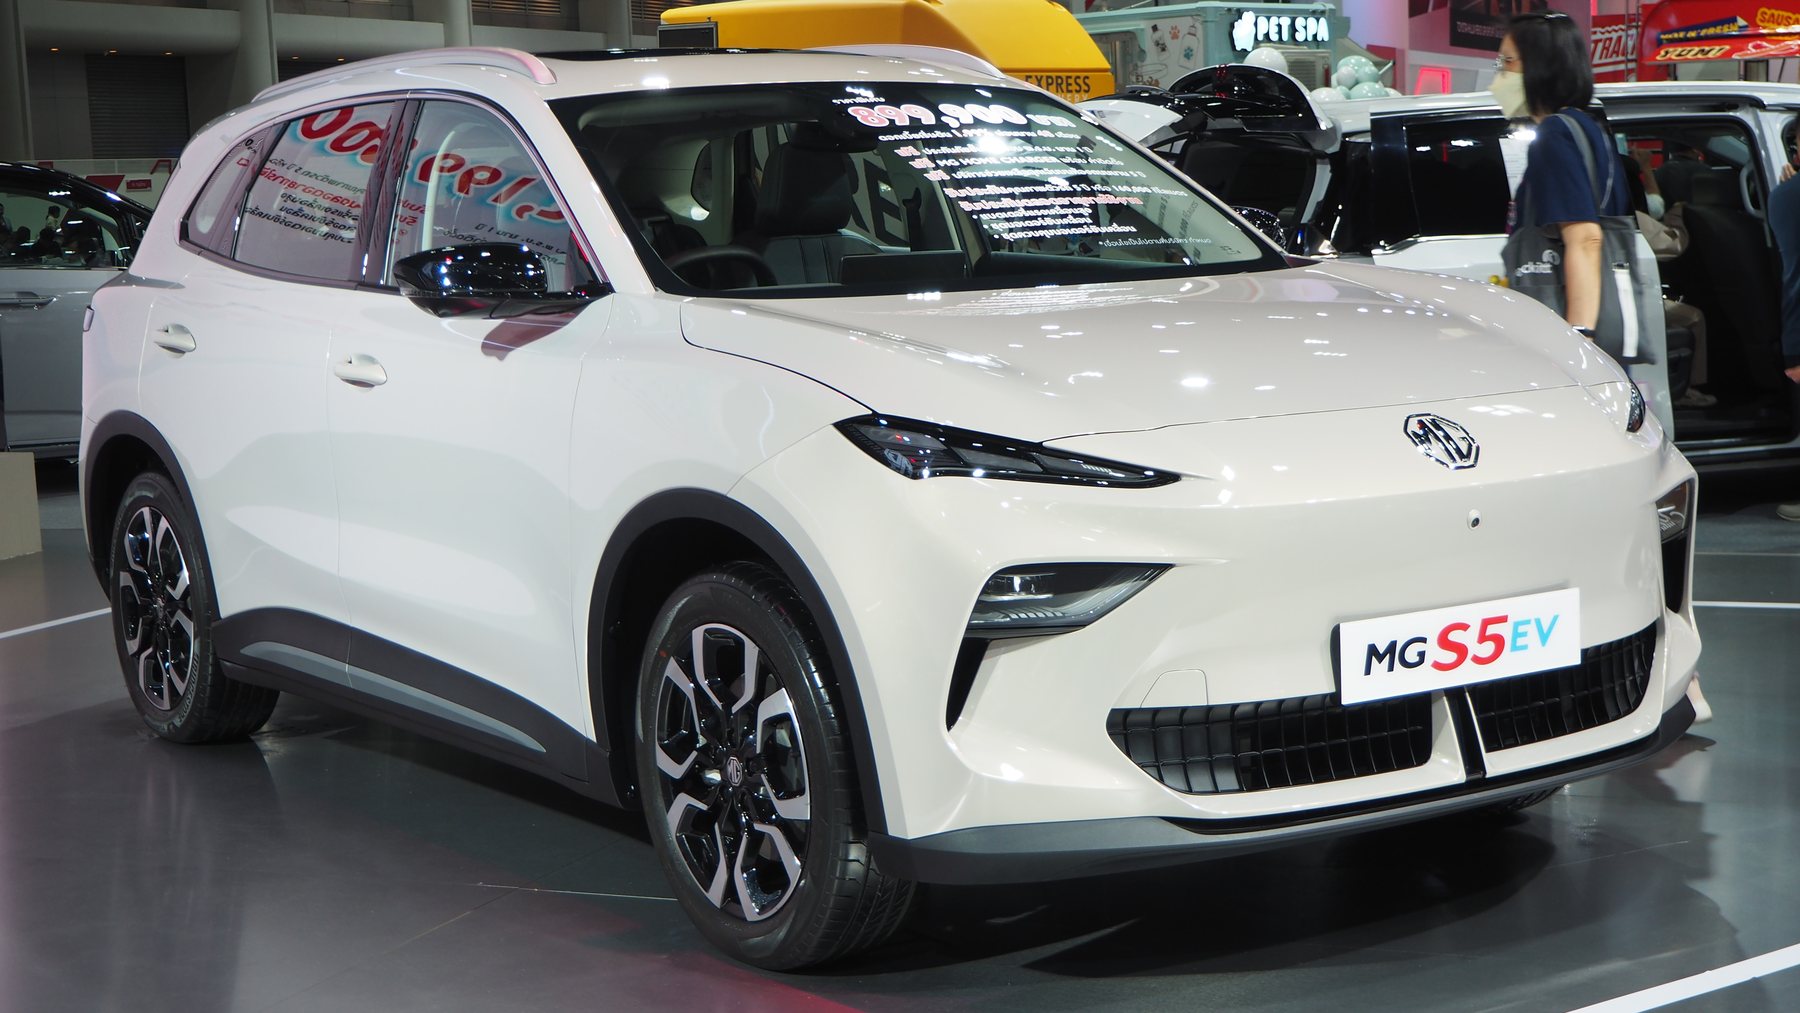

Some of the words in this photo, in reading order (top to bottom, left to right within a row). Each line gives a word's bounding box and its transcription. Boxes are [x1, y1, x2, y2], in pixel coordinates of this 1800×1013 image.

[1256, 15, 1291, 42] PET
[1294, 16, 1329, 42] SPA
[847, 103, 1028, 128] 899,900
[1025, 113, 1077, 128] บาท
[894, 145, 921, 157] ฟรี
[908, 157, 936, 169] ฟรี
[935, 158, 959, 168] MG
[959, 156, 1000, 167] HOME
[1000, 156, 1060, 165] CHARGER
[923, 169, 950, 181] ฟรี
[1405, 414, 1480, 469] MG
[1363, 636, 1428, 676] MG
[1430, 614, 1509, 673] S5
[1510, 614, 1560, 653] EV
